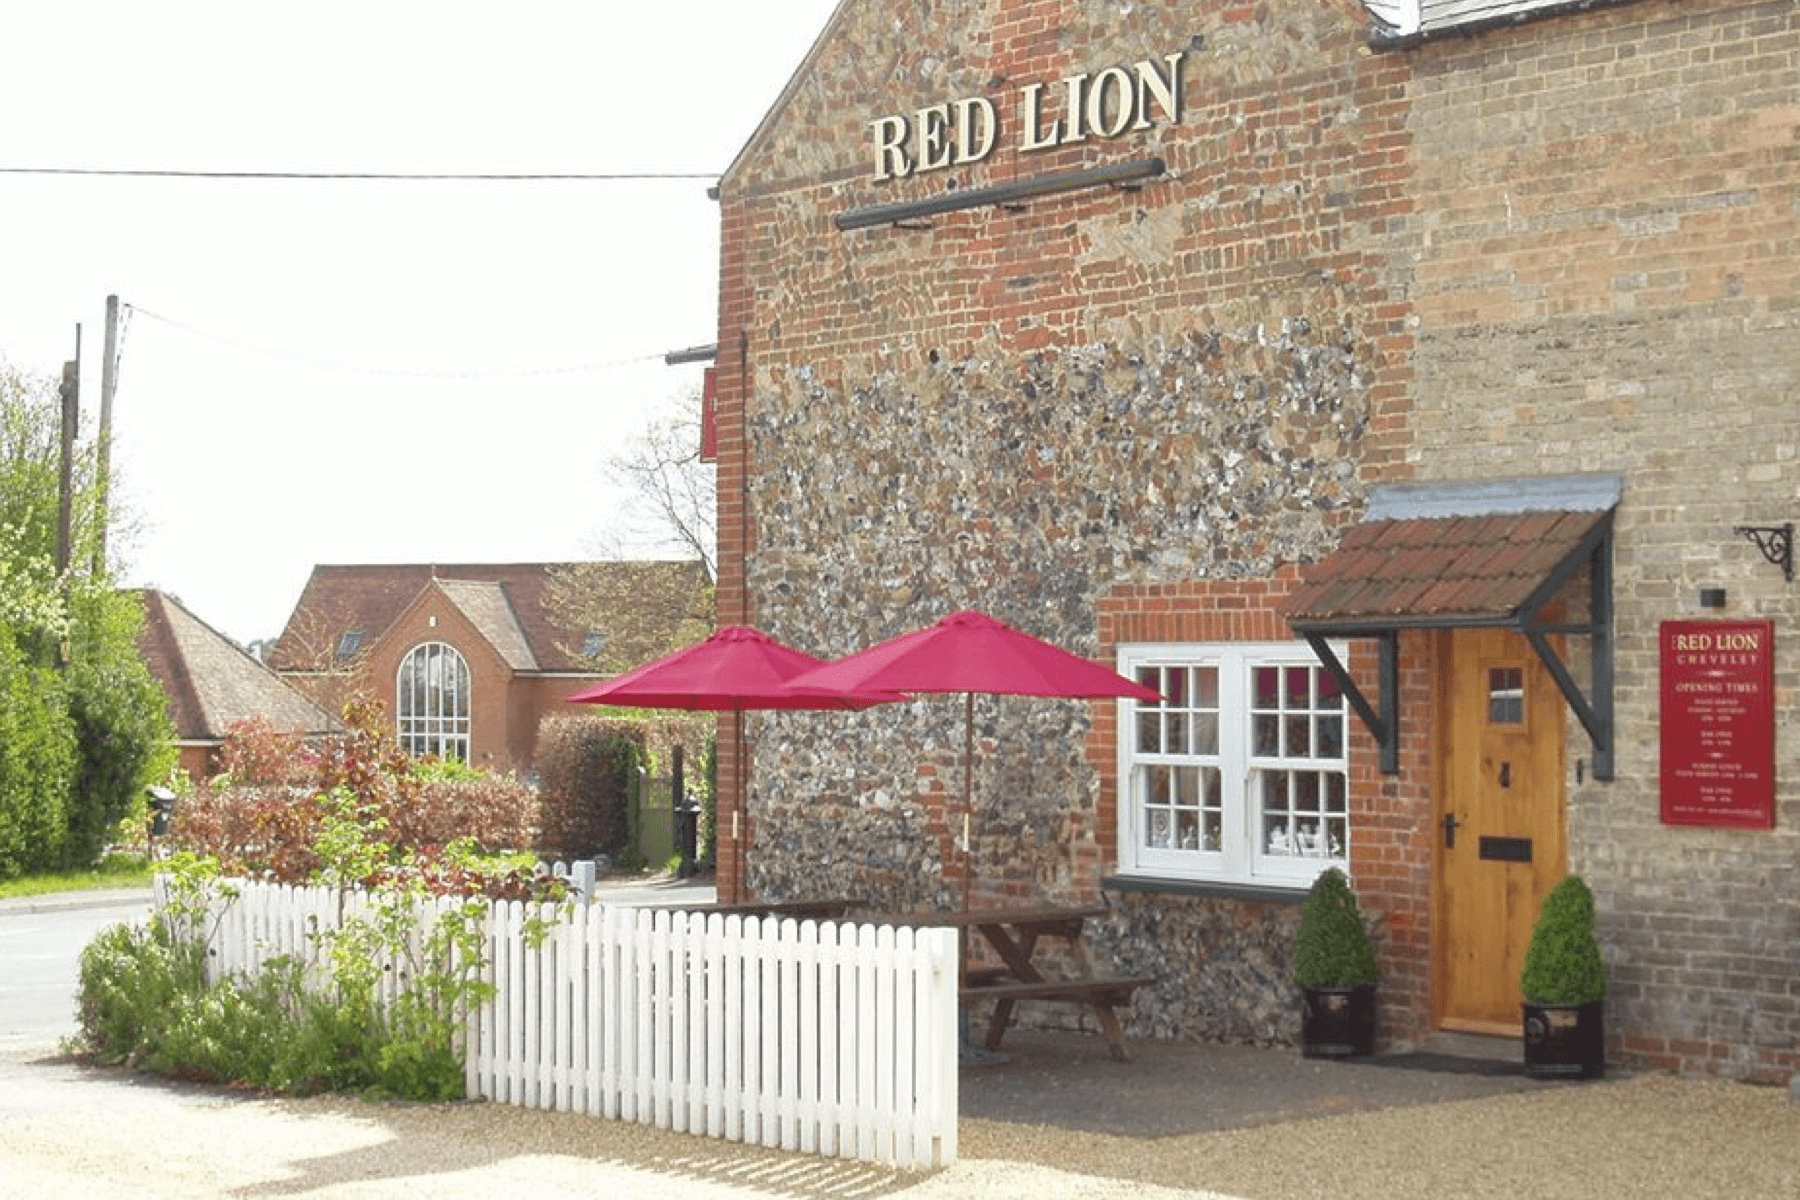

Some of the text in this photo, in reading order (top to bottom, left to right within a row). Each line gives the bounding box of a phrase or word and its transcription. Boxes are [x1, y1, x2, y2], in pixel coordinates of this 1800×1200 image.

[869, 52, 1184, 182] RED LION
[1677, 633, 1712, 651] RED
[1716, 633, 1758, 651] LION
[1675, 683, 1758, 694] OPENING TIMES
